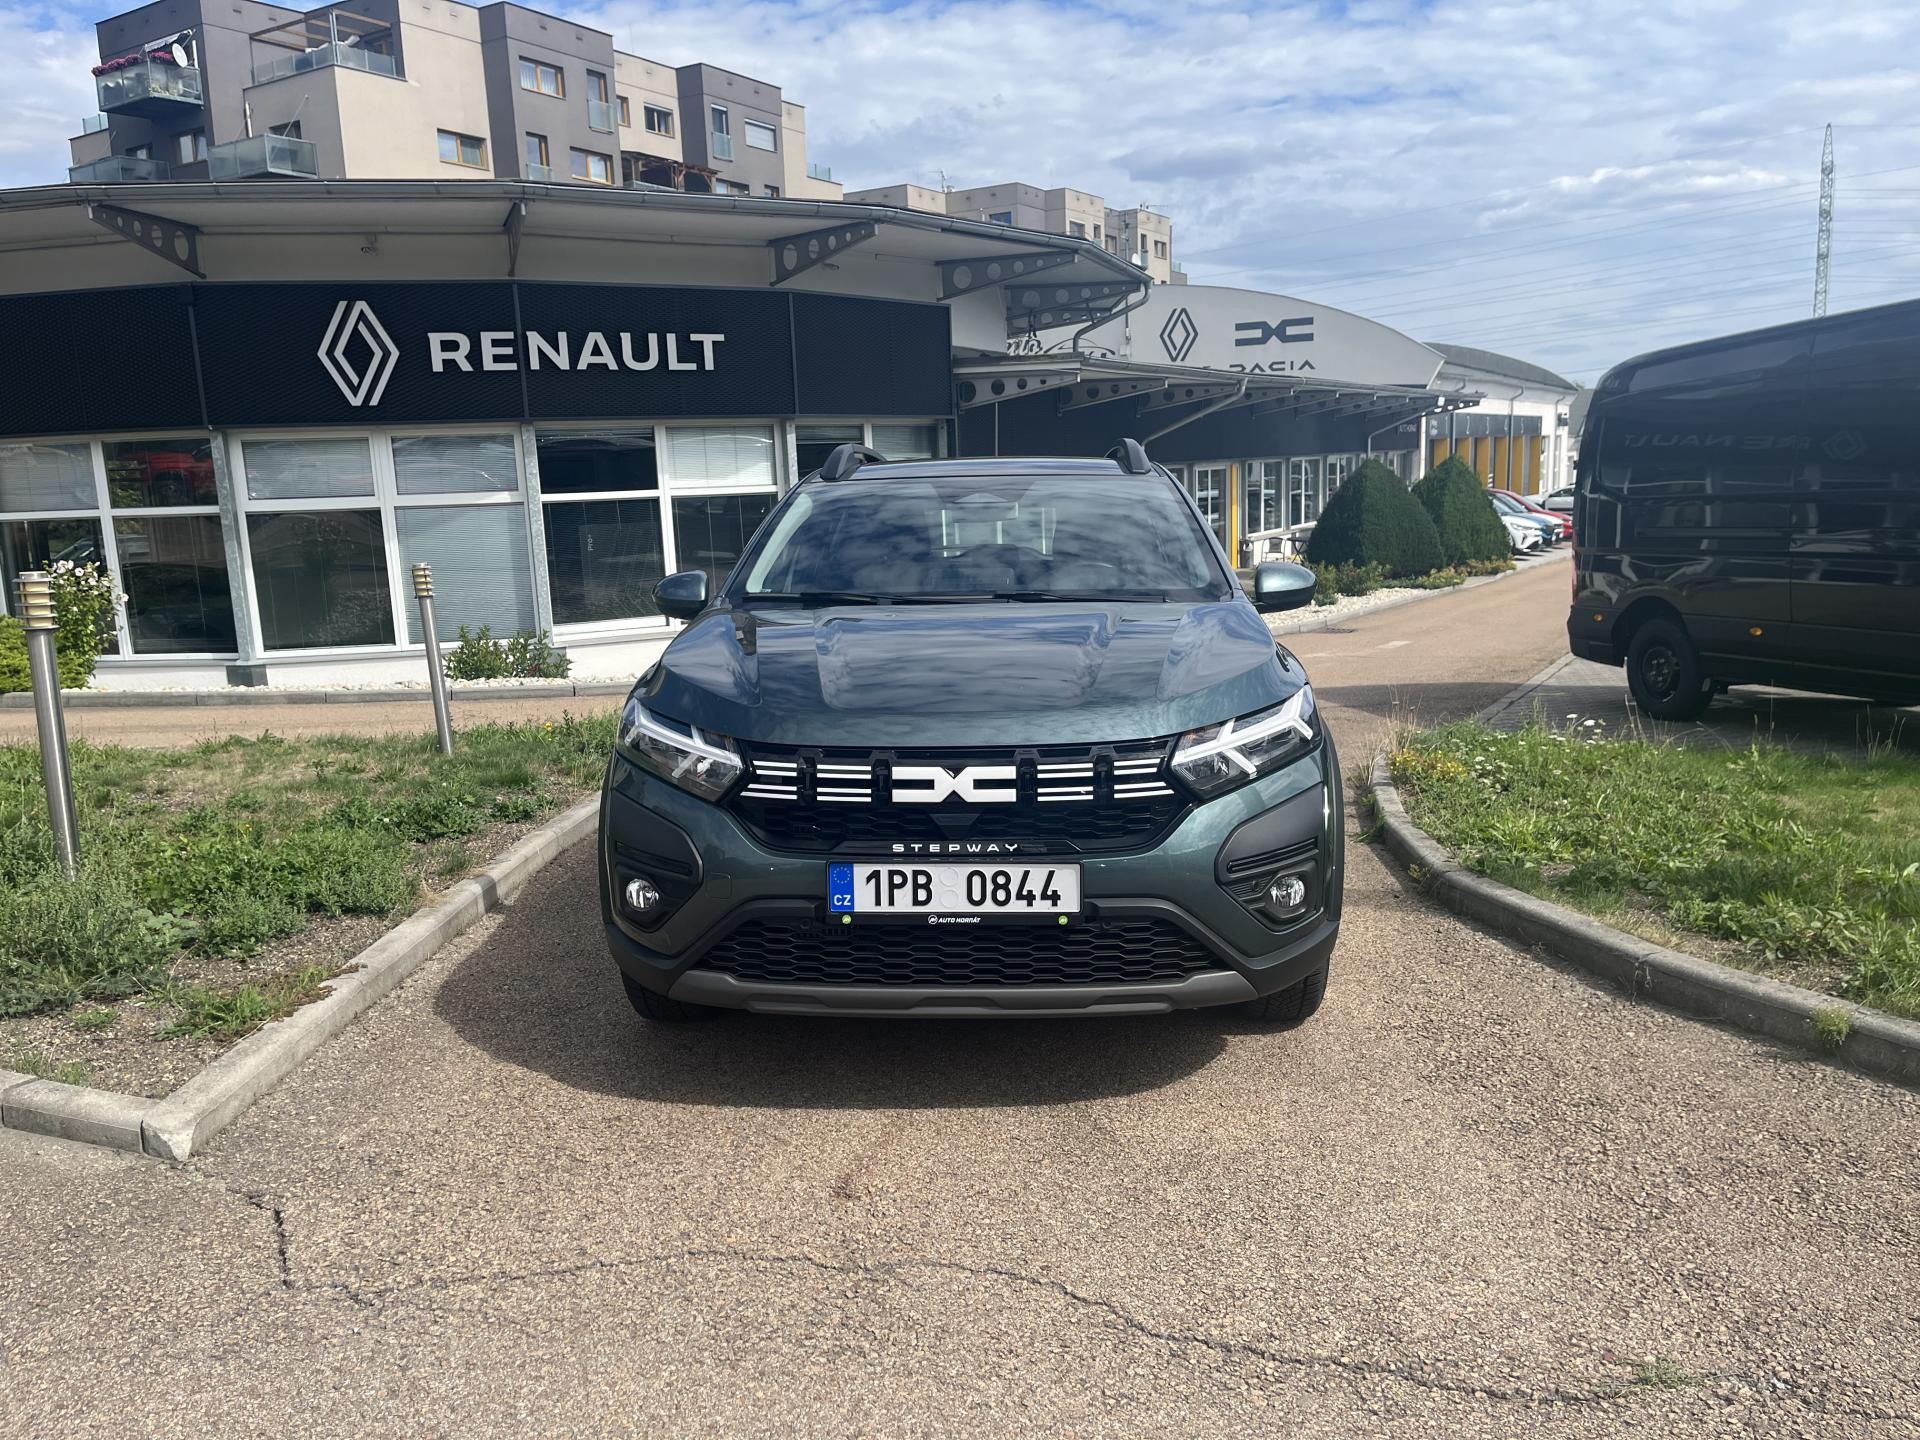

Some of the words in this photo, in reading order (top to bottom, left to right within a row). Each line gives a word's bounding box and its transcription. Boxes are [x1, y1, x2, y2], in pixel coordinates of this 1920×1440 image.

[427, 331, 725, 372] RENAULT
[1228, 359, 1317, 374] DACIA
[892, 843, 1018, 853] STEPWAY
[865, 869, 933, 907] 1PB
[966, 869, 1061, 907] 0844
[833, 894, 851, 906] CZ
